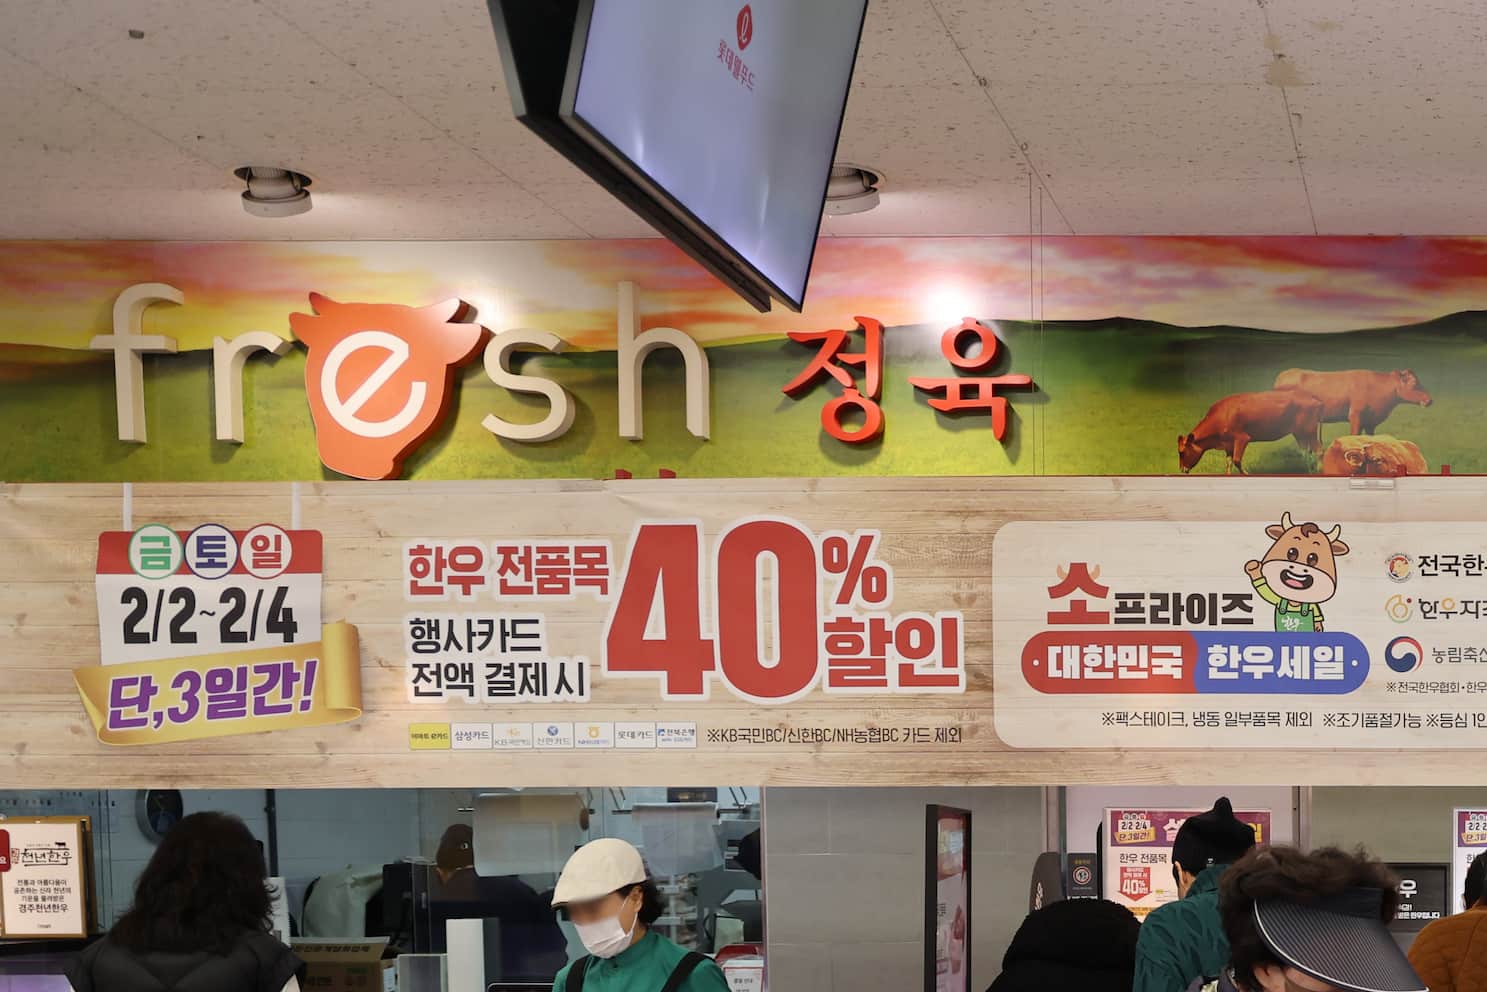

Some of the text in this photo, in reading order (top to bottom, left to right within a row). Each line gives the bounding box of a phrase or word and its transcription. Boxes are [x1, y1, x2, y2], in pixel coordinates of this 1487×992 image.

[89, 280, 711, 445] fresh
[408, 544, 610, 597] 한우 전품목
[1047, 562, 1254, 626] 소프라이즈
[410, 616, 542, 655] 행사카드
[823, 616, 960, 688] 할인
[411, 662, 475, 698] 전액
[484, 661, 548, 698] 결제
[1047, 645, 1345, 681] 대한민국 한우세일
[902, 727, 931, 744] 카드
[934, 727, 963, 744] 제외
[1192, 710, 1221, 727] 냉동
[1223, 711, 1282, 728] 일부품목
[1285, 711, 1314, 728] 제외
[1119, 853, 1168, 864] 한우 전품목
